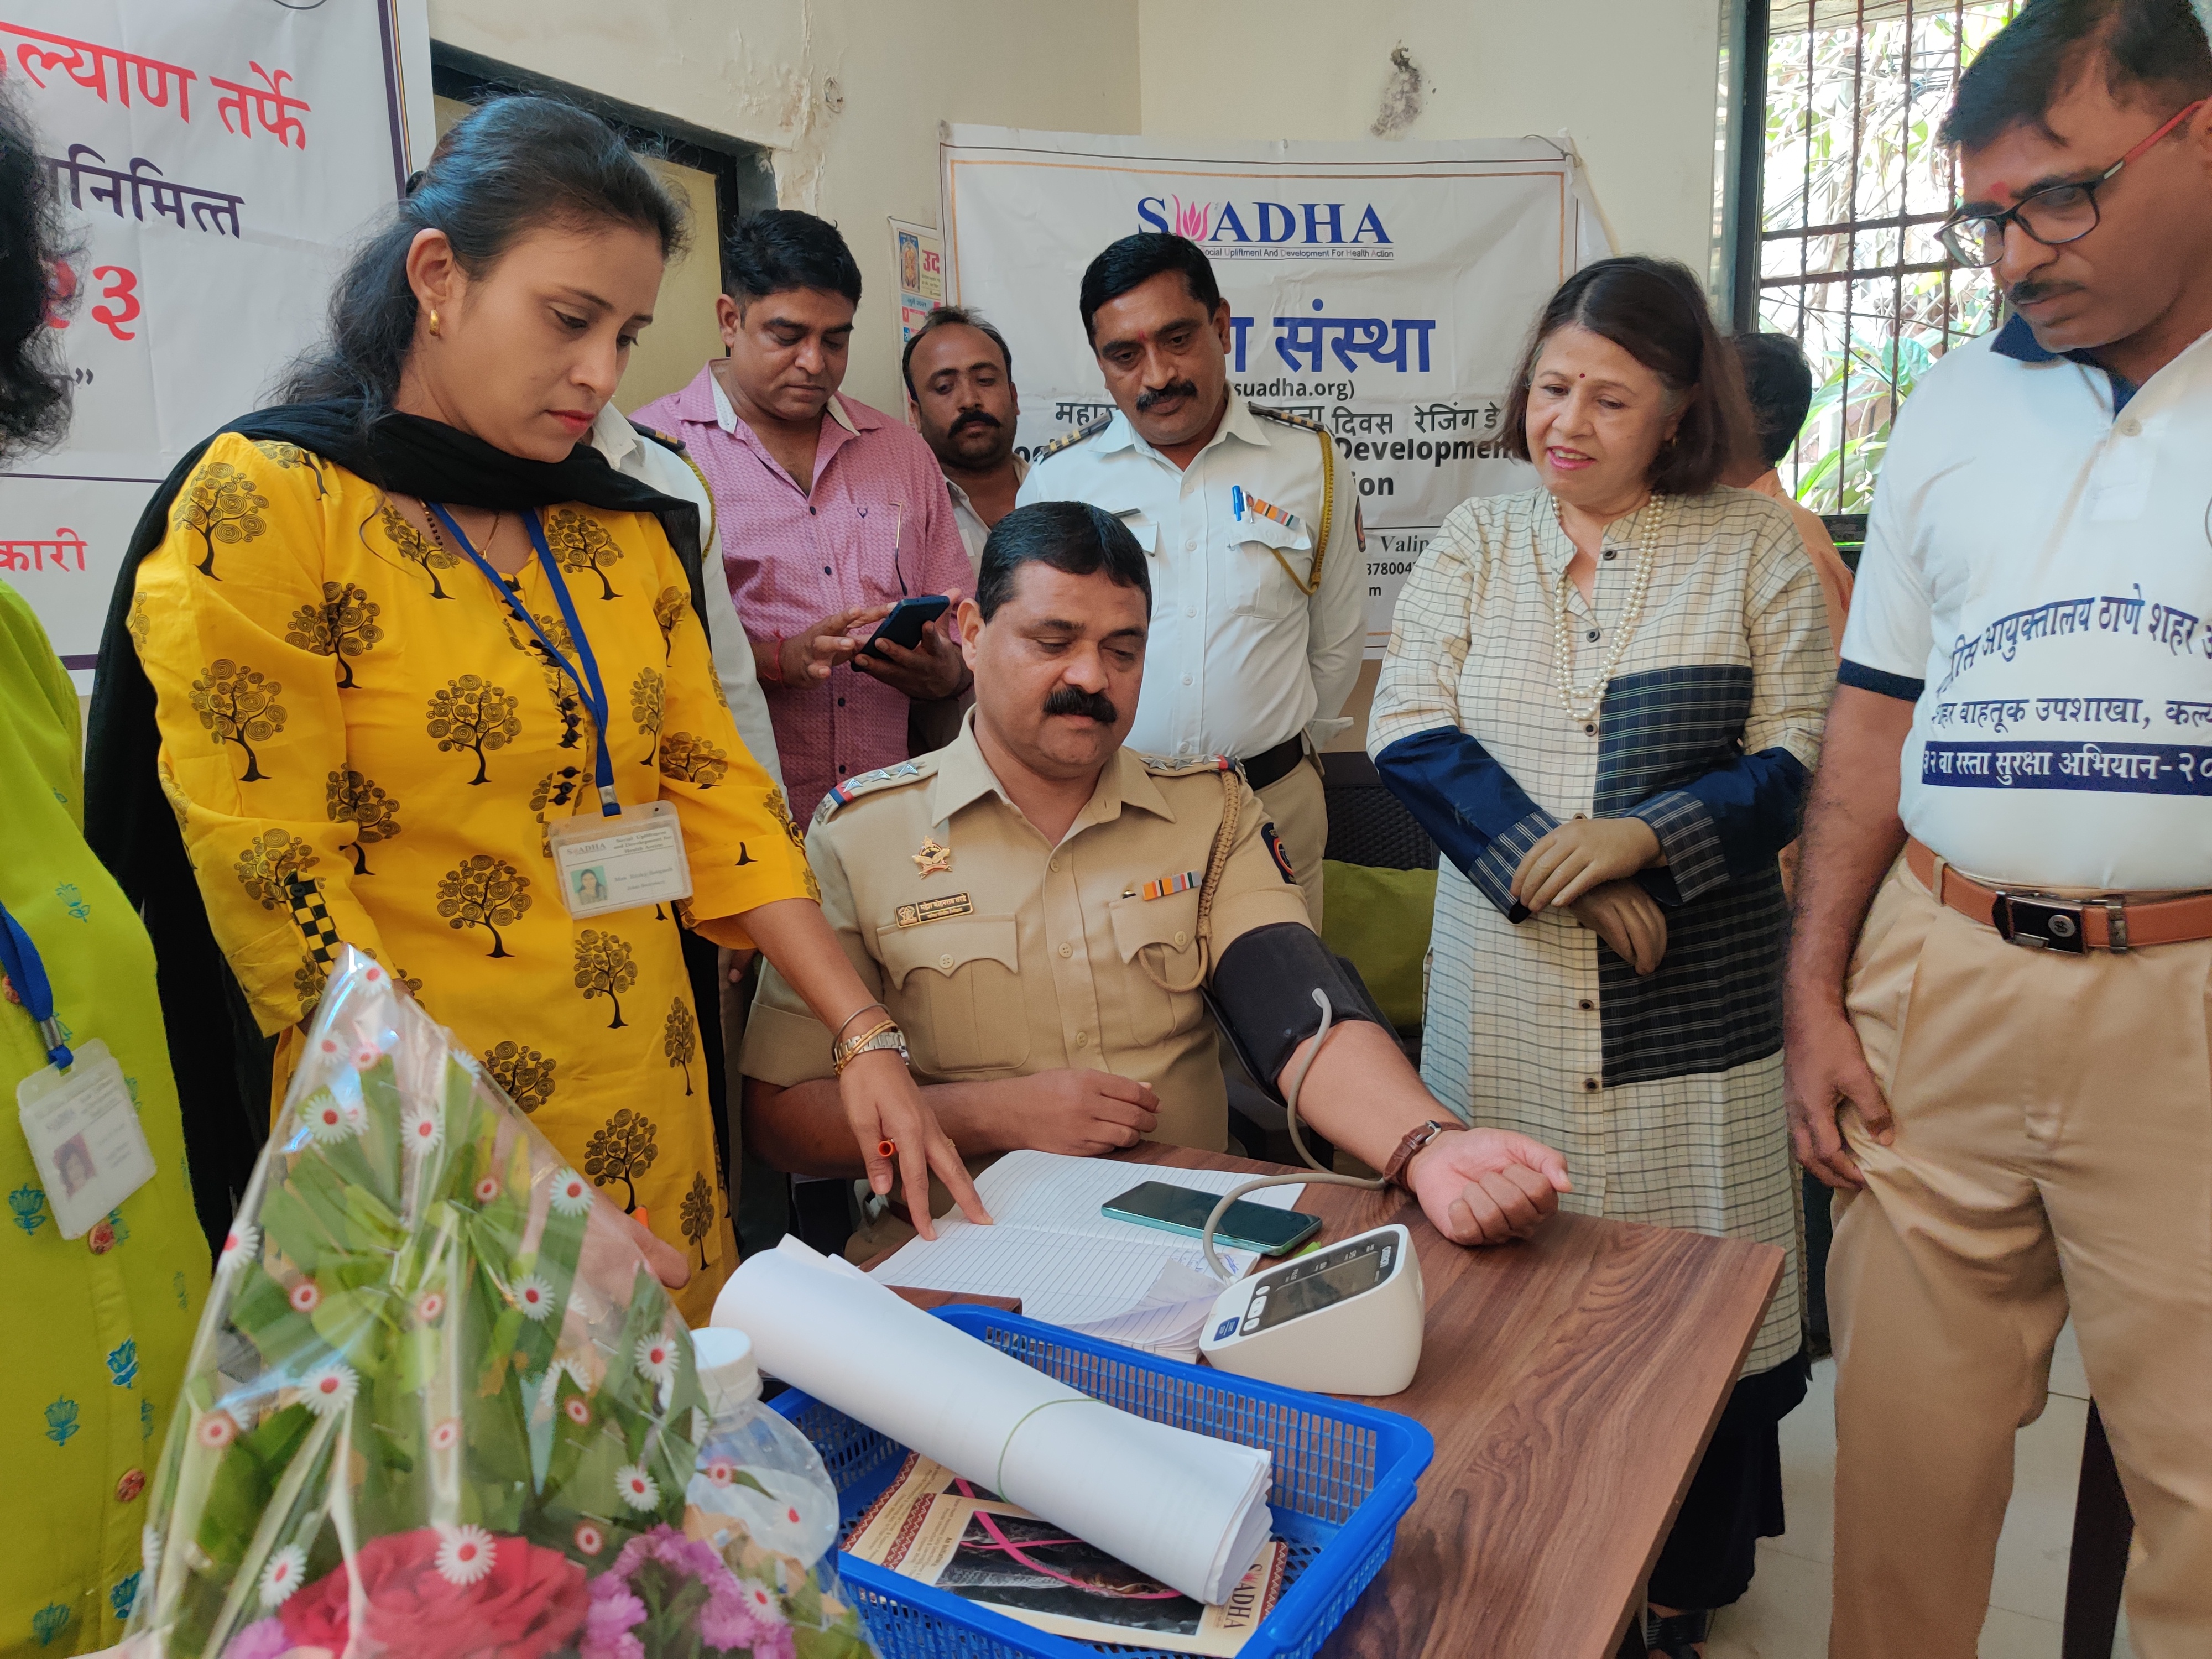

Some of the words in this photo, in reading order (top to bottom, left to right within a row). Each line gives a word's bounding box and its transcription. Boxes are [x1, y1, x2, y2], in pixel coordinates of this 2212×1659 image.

[0, 22, 197, 124] ल्याण
[209, 60, 311, 150] तर्फे
[41, 143, 245, 239] निमित्त
[1224, 248, 1262, 258] Upliftment
[1264, 248, 1279, 257] And
[1281, 249, 1329, 258] Development
[1346, 249, 1369, 257] Health
[1273, 298, 1436, 373] संस्था
[1331, 406, 1393, 436] दिवस
[1413, 401, 1479, 434] रेजिंग
[1366, 562, 1416, 576] 378004
[2099, 583, 2146, 635] ठाणे
[2148, 603, 2199, 656] शहर
[1960, 698, 2030, 733] वाहतूक
[2036, 698, 2151, 730] उपशाखा,
[1956, 752, 1992, 775] रस्ता
[1995, 751, 2054, 786] सुरक्षा
